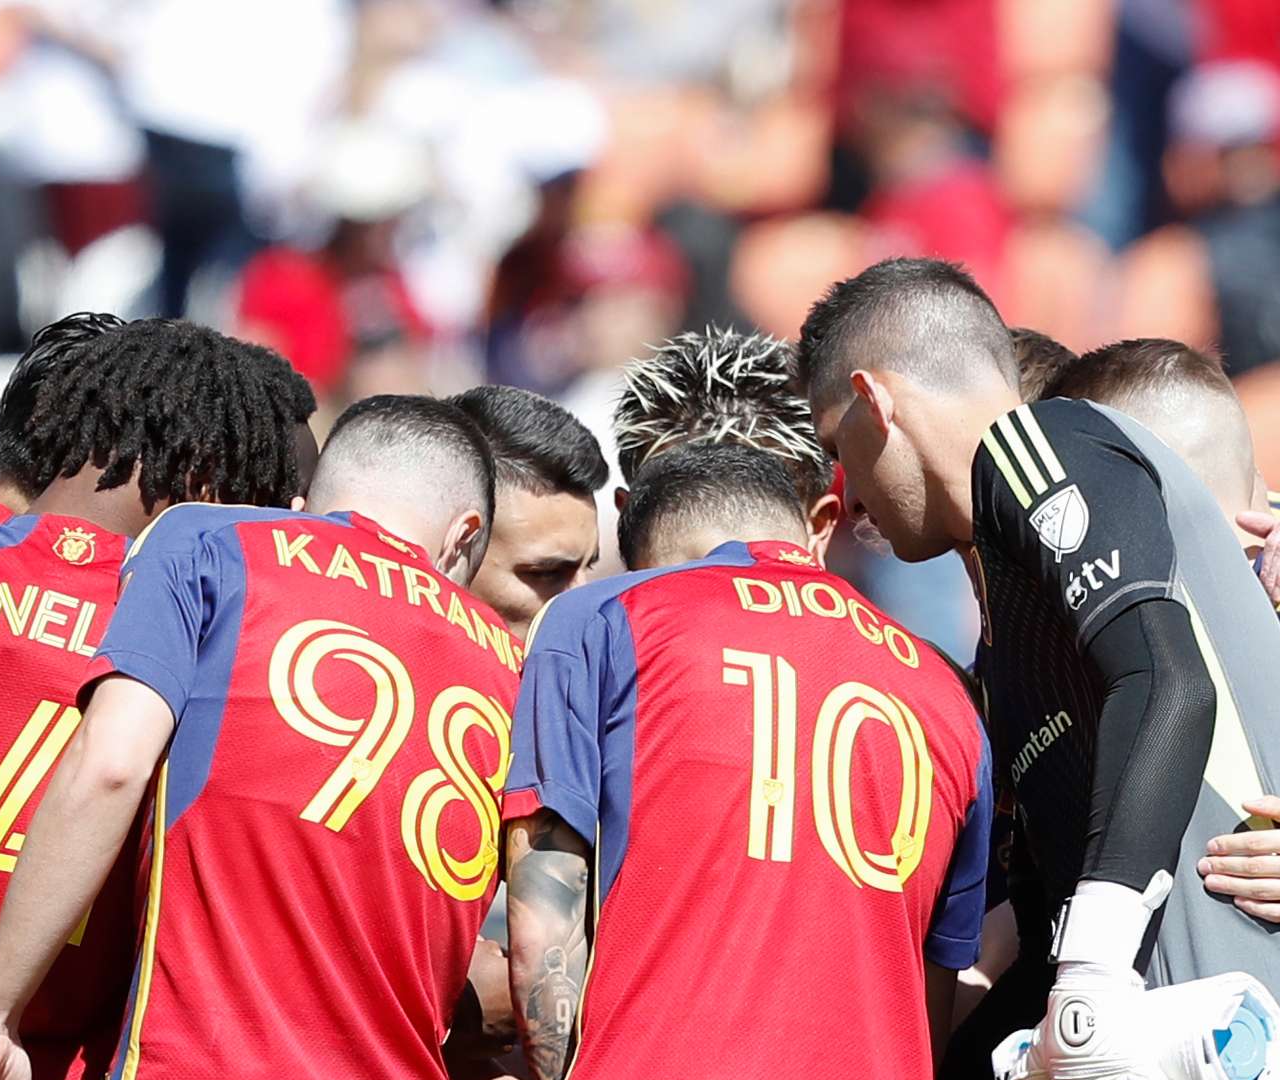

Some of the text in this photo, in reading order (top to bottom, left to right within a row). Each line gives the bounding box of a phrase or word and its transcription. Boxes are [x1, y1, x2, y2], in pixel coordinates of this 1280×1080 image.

[1081, 549, 1120, 590] tv
[732, 577, 920, 669] DIOGO
[268, 619, 513, 902] 98
[722, 647, 934, 893] 10
[1010, 710, 1073, 786] ountain
